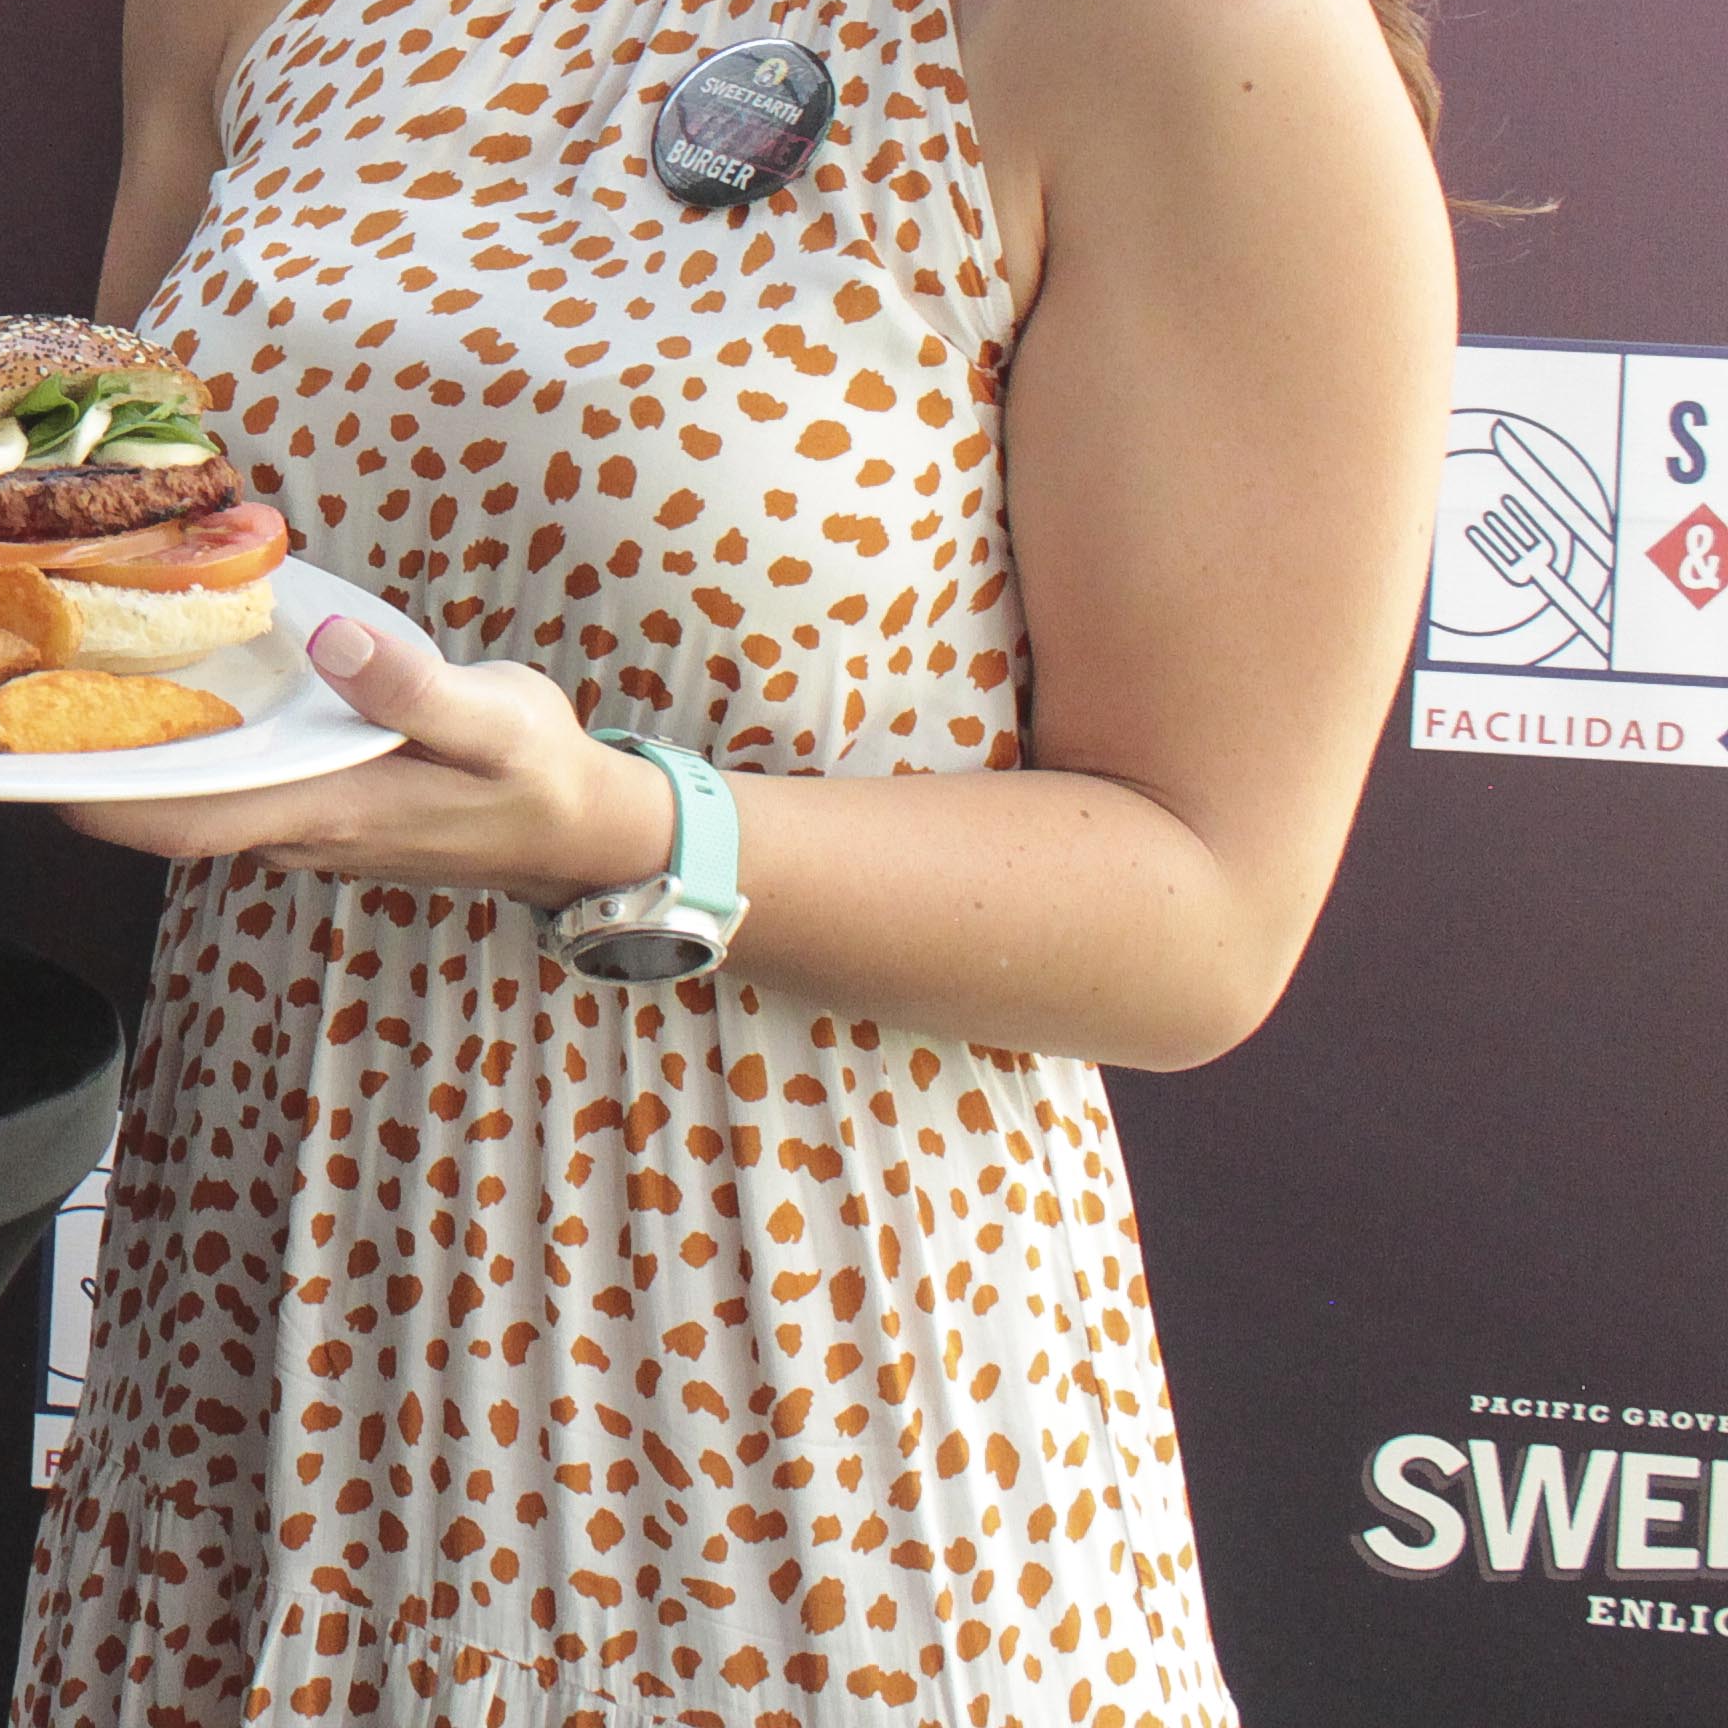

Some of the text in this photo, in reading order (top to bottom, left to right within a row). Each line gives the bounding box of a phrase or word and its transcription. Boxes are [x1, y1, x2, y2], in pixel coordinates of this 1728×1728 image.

[700, 76, 752, 104] SWEET
[751, 94, 805, 126] EARTH
[666, 139, 755, 191] BURGER
[1679, 524, 1721, 591] &
[1425, 708, 1685, 752] FACILIDAD
[1470, 1395, 1611, 1423] PACIFIC
[1362, 1434, 1728, 1571] SWE
